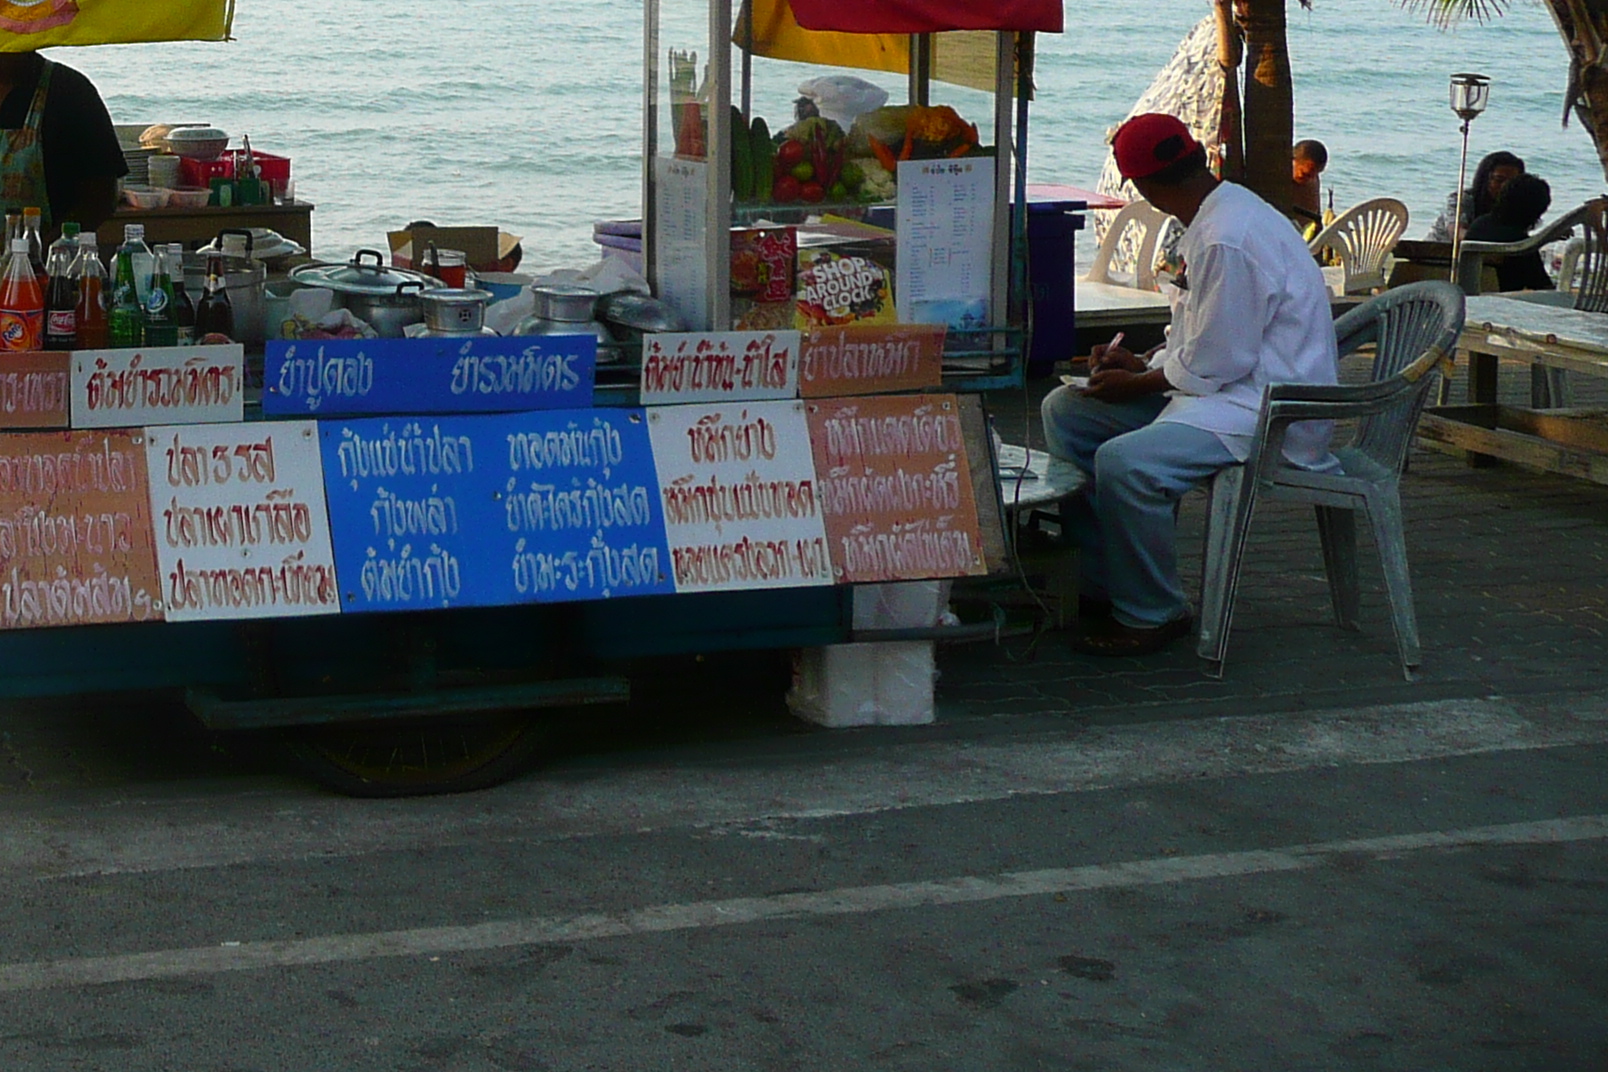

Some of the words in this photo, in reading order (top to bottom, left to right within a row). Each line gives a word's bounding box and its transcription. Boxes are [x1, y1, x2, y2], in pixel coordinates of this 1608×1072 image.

[807, 271, 873, 302] AROUND
[813, 257, 866, 283] SHOP
[823, 286, 871, 311] CLOCK
[86, 354, 236, 410] ต้มยำรวมมิตร
[278, 345, 374, 411] ยำปูดอง
[450, 340, 580, 395] ยำรวมมิตร
[337, 423, 474, 491] กุ้งแช่น้ำปลา
[507, 417, 623, 481] ทอดมันกุ้ง
[687, 409, 776, 462] หมึกย่าง
[163, 488, 312, 548] ปลาเผาเกลือ
[370, 483, 458, 552] กุ้งพล่า
[361, 542, 461, 609] ต้มยำกุ้ง
[512, 536, 659, 598] ยำมะระกุ้งสด
